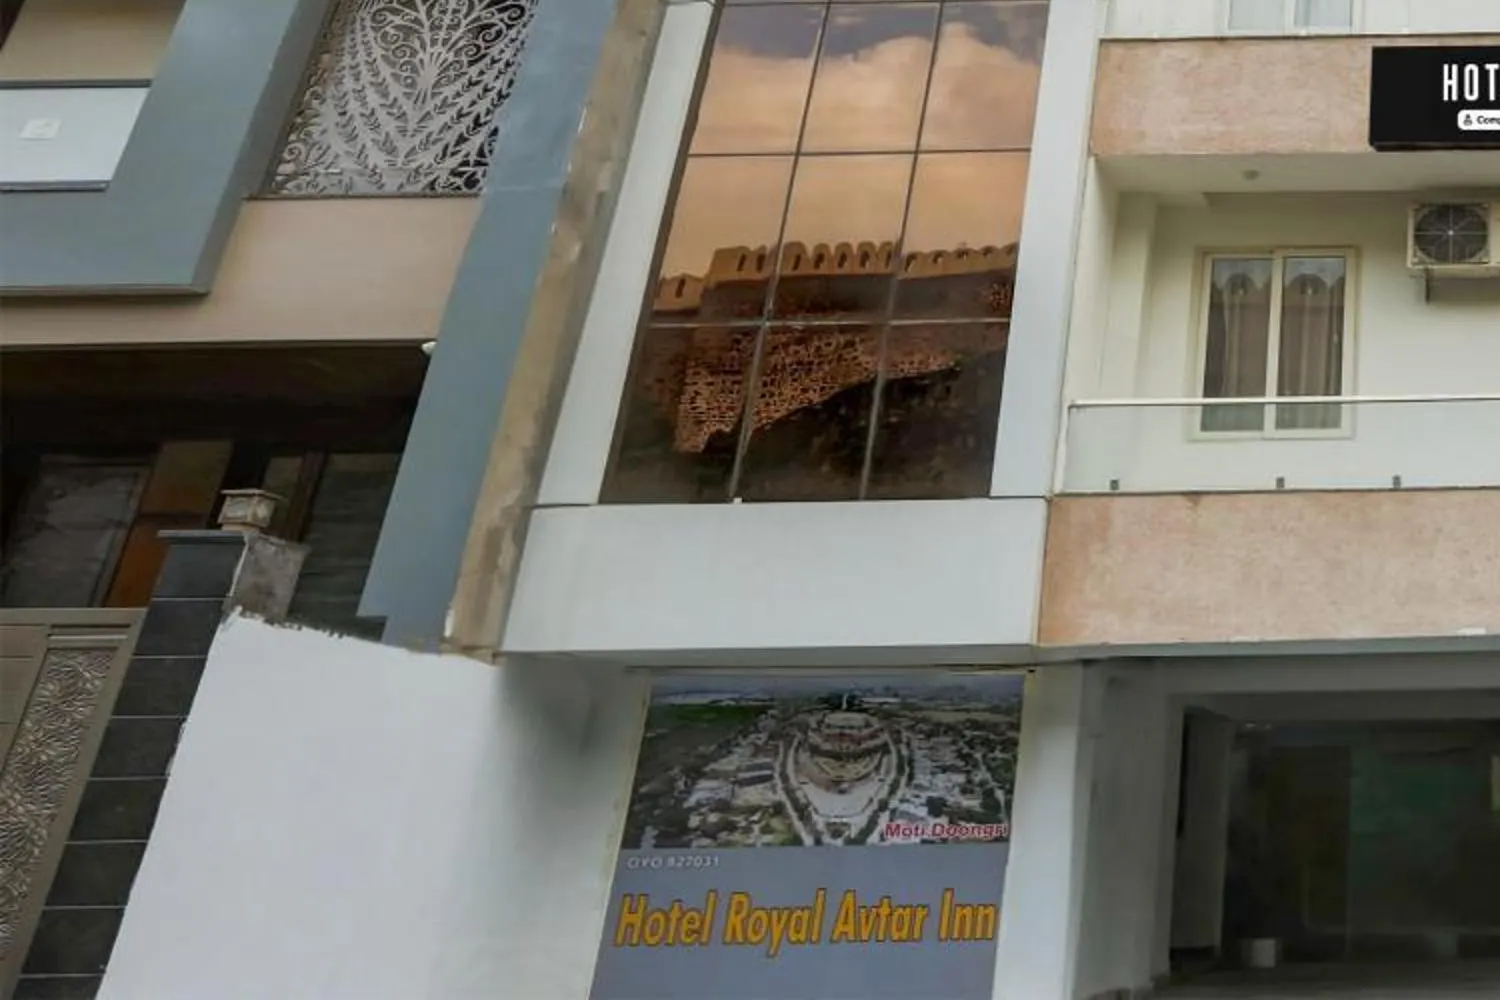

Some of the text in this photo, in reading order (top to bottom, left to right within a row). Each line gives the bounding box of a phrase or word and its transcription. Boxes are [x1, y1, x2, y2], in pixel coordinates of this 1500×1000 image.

[614, 888, 998, 956] Hotel Royal Avtar Inn
